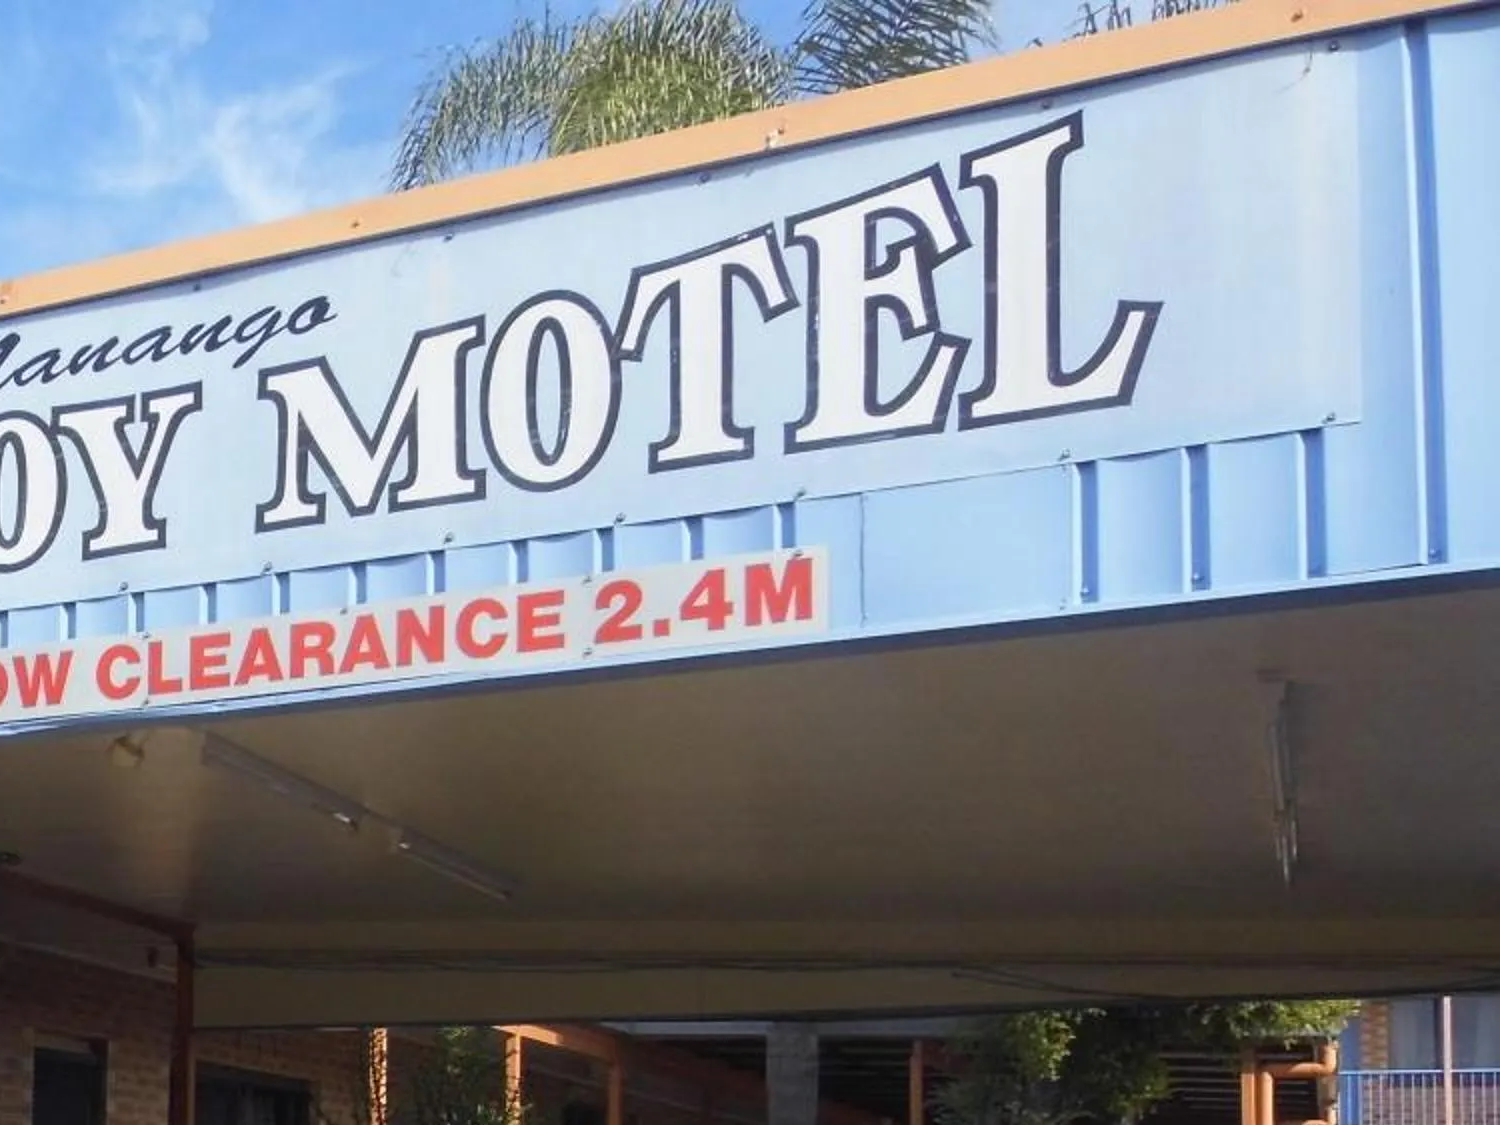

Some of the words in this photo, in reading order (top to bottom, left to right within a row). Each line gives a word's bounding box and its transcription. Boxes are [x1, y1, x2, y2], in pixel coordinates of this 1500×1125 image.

[254, 110, 1163, 534] MOTEL
[95, 588, 567, 701] CLEARANCE
[593, 557, 816, 645] 2.4M
